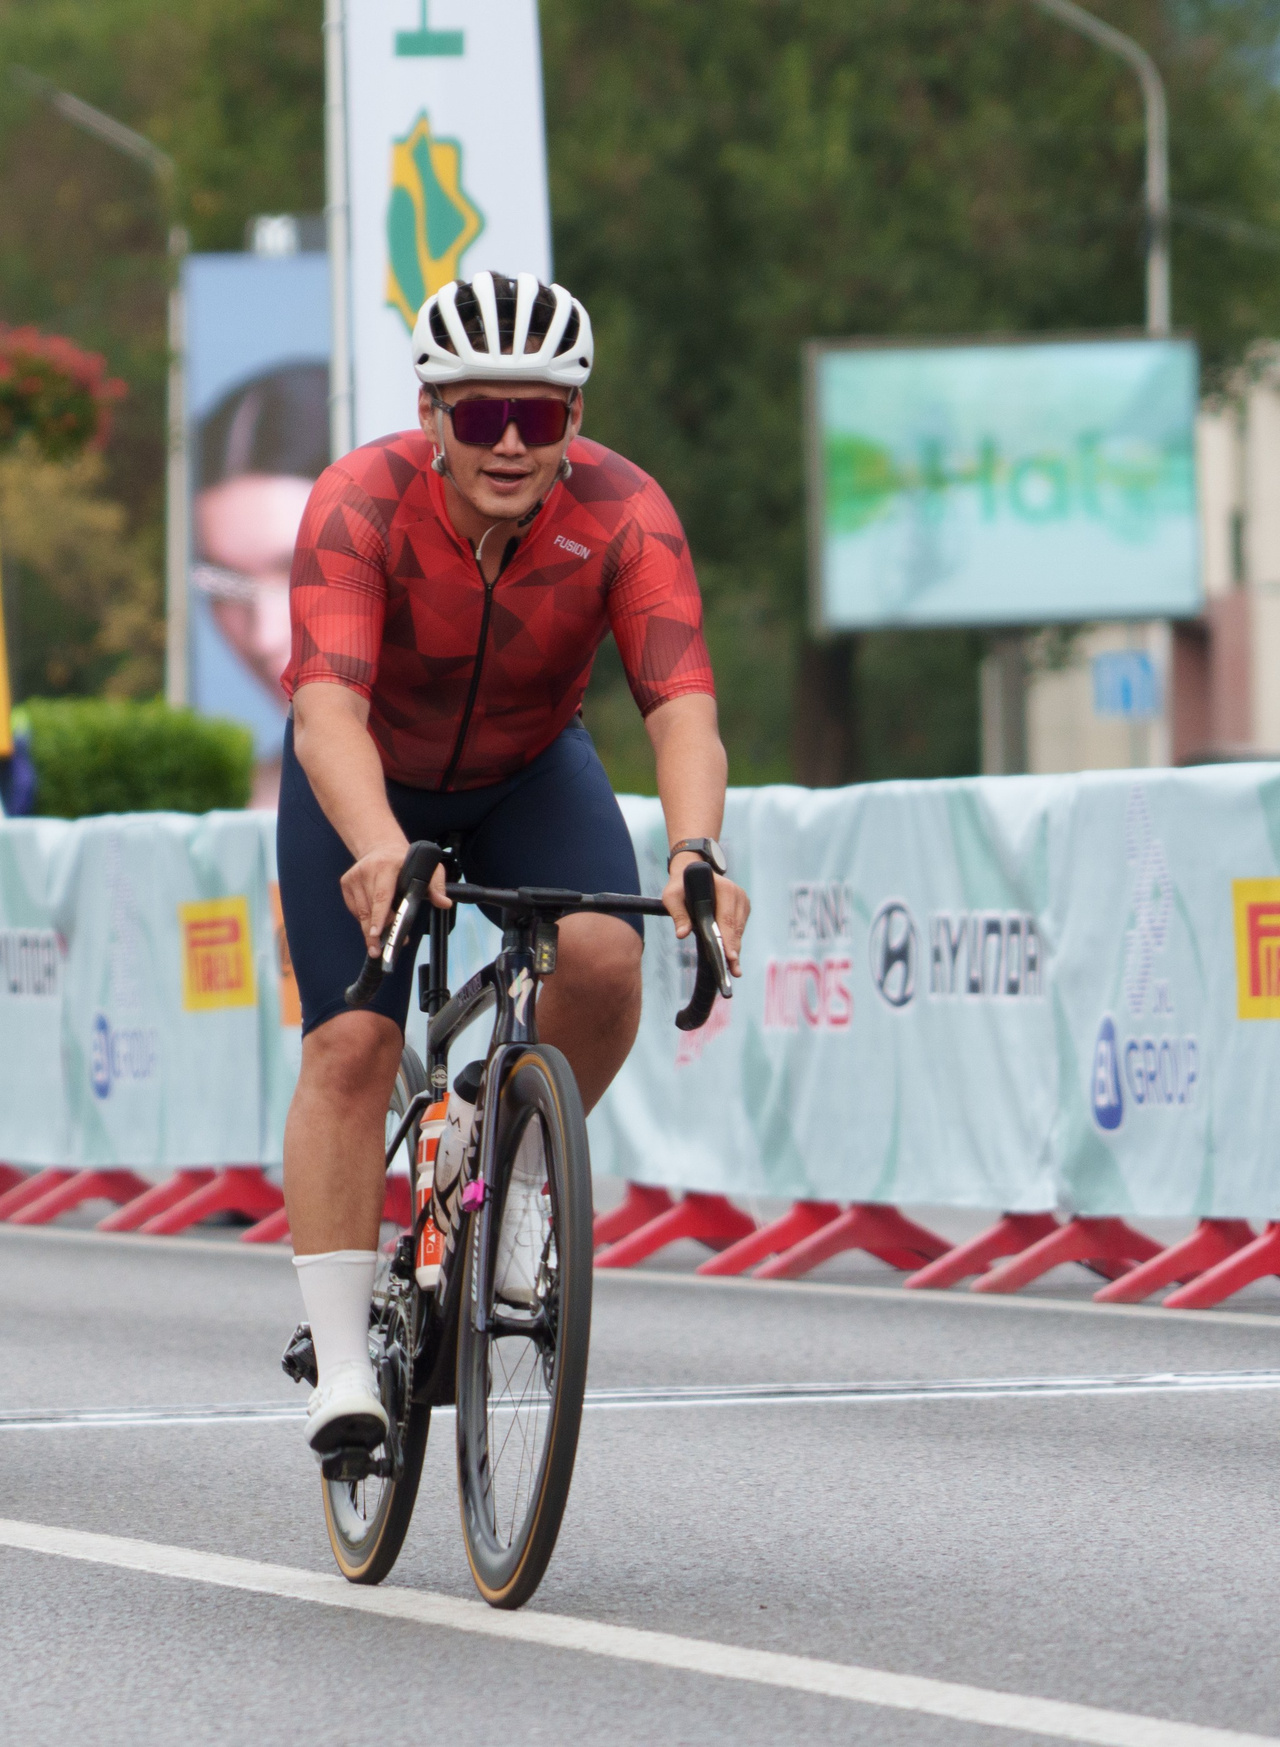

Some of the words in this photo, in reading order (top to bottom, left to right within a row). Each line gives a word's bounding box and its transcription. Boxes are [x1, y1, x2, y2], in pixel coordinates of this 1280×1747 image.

[553, 534, 591, 560] FUSION
[928, 916, 1042, 995] HYUNDA
[425, 1223, 436, 1254] DAK
